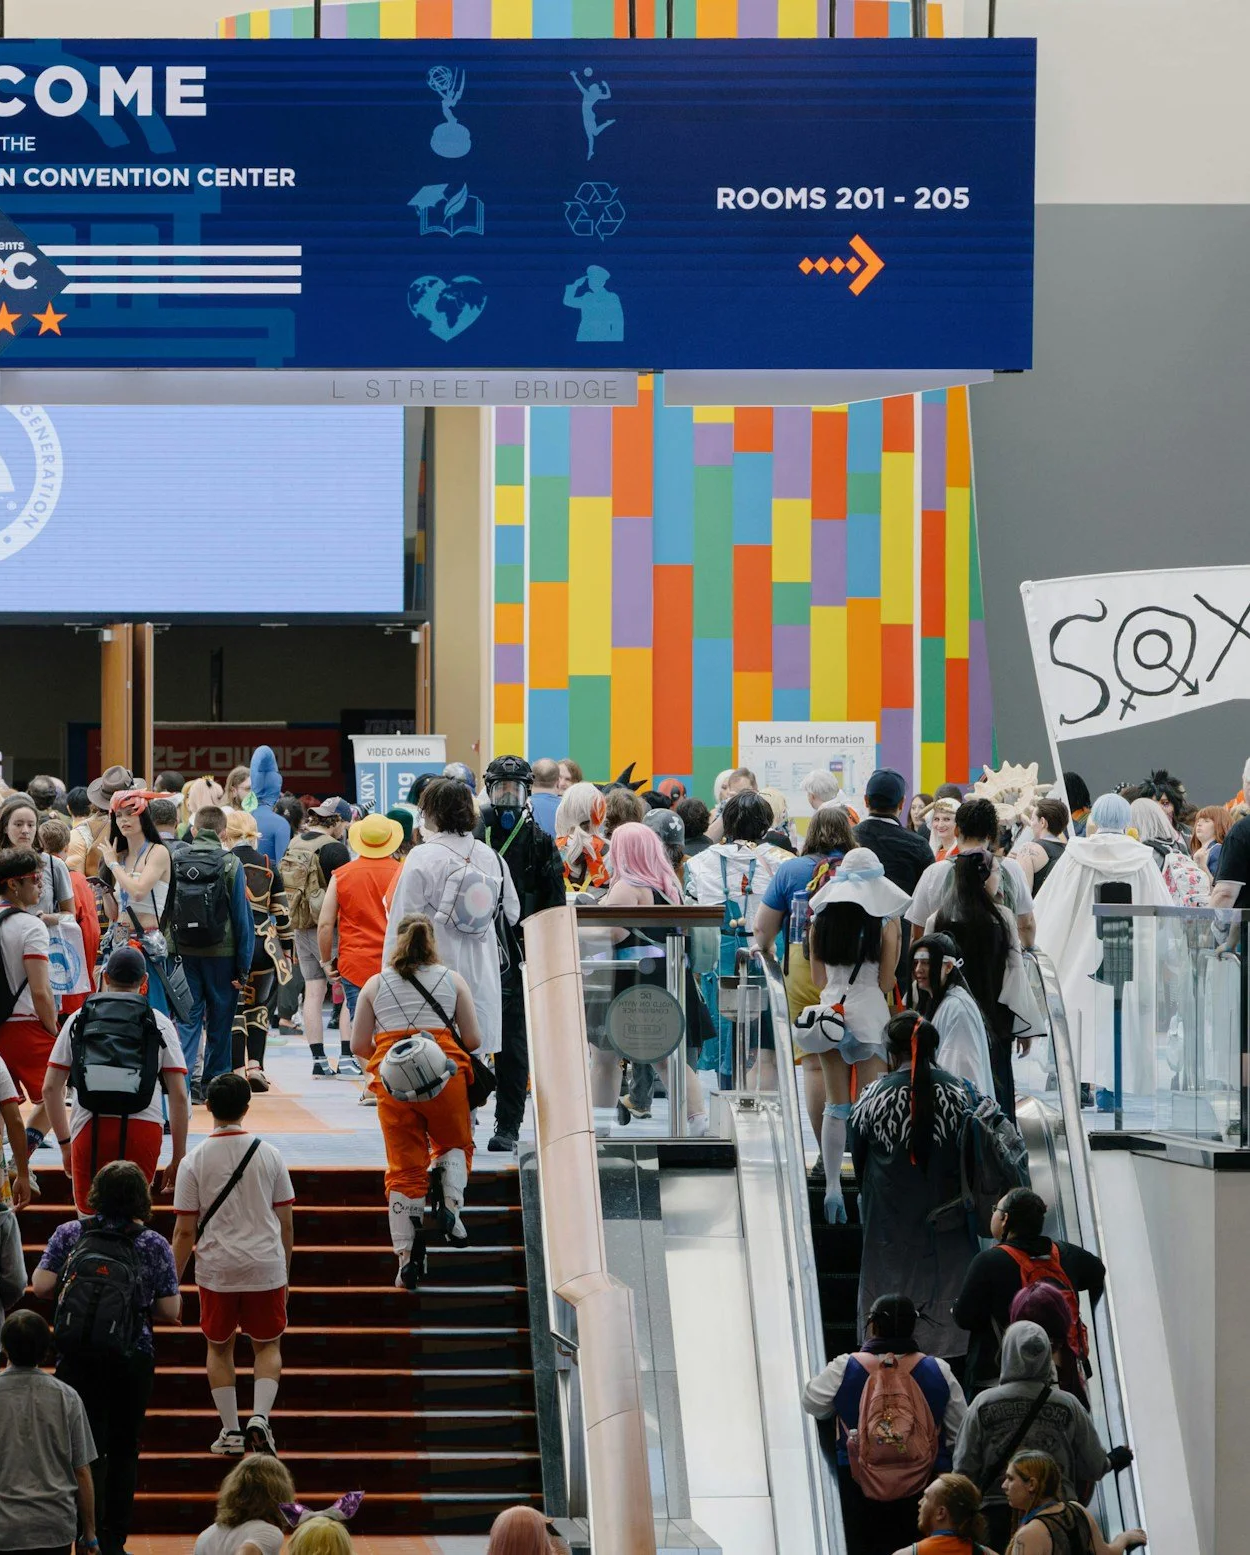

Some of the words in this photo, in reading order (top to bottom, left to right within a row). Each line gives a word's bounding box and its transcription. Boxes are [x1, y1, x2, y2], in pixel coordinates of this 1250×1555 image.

[23, 167, 190, 187] CONVENTION
[197, 167, 296, 187] CENTER
[716, 187, 827, 210] ROOMS
[835, 187, 885, 210] 201
[914, 187, 970, 210] 205
[332, 379, 345, 398] L
[365, 378, 491, 399] STREET
[515, 378, 618, 399] BRIDGE
[19, 405, 56, 530] GENERATION
[755, 734, 781, 746] Maps
[784, 734, 802, 744] and
[805, 734, 865, 744] Information
[367, 747, 393, 757] VIDEO
[395, 747, 431, 757] GAMING
